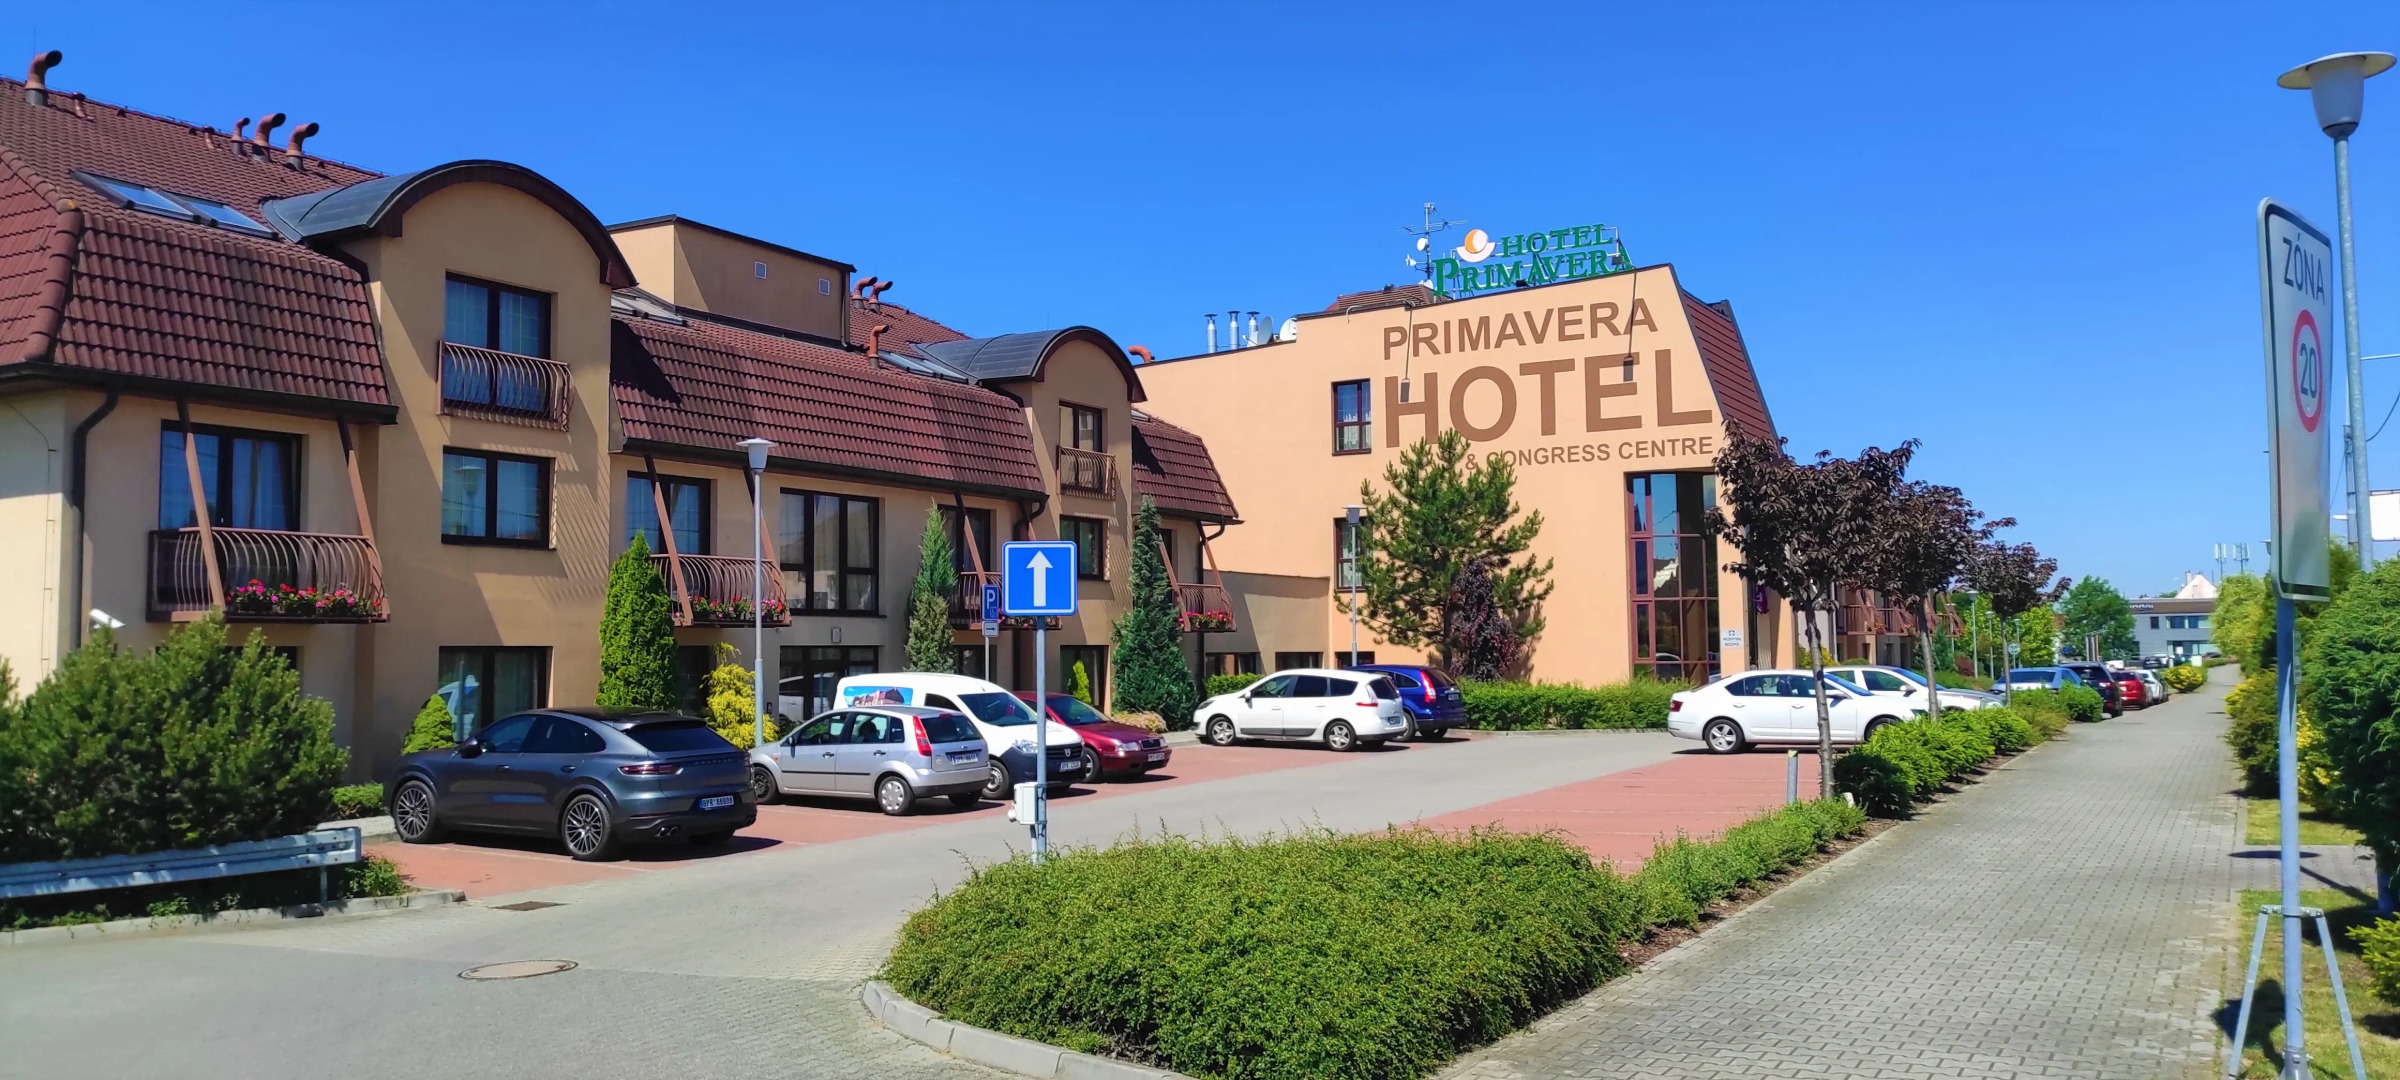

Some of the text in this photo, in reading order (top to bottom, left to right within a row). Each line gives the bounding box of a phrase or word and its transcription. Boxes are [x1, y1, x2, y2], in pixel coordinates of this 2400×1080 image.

[1501, 224, 1614, 258] HOTEL
[2283, 233, 2325, 304] ZÓNA
[1432, 243, 1634, 297] PRIMAVERA
[1383, 297, 1658, 360] PRIMAVERA
[1384, 348, 1713, 448] HOTEL
[2300, 343, 2317, 399] 20
[1486, 442, 1610, 468] CONGRESS
[1618, 436, 1713, 460] CENTRE
